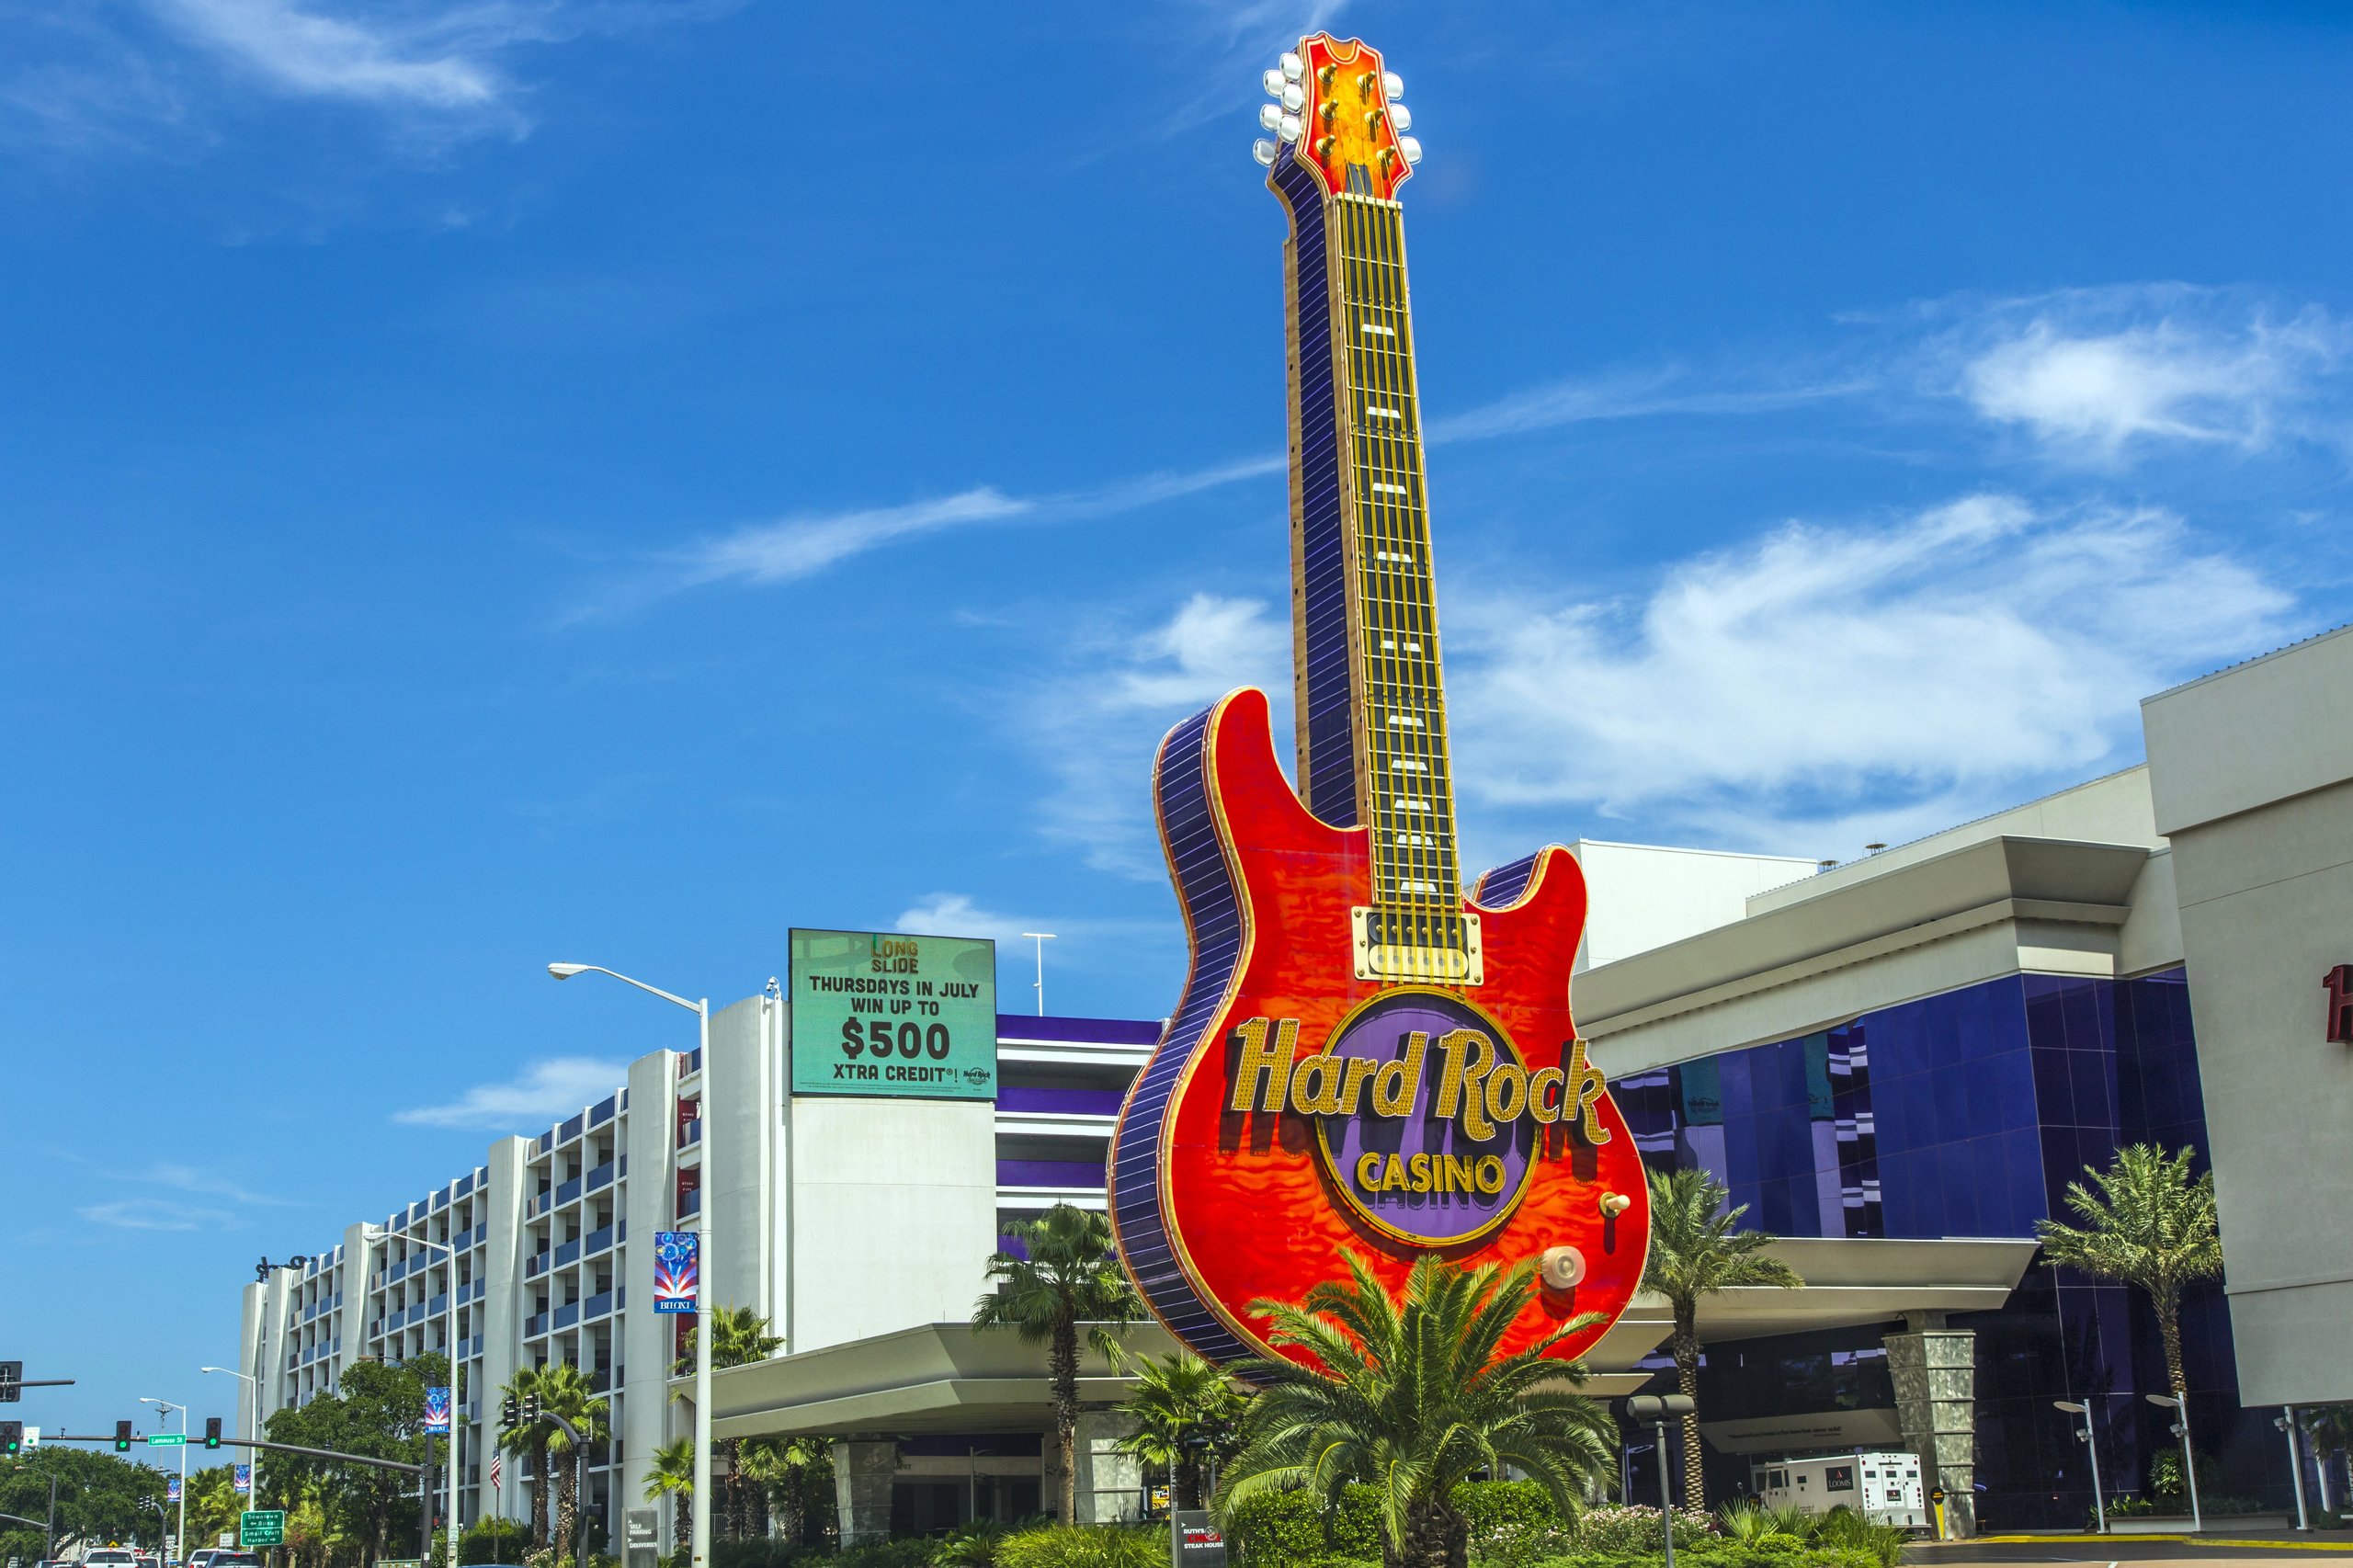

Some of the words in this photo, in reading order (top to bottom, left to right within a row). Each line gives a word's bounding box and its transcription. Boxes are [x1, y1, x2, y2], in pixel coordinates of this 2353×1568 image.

[871, 939, 919, 959] LONG
[871, 958, 919, 974] SLIDE
[809, 976, 910, 995] THURSDAYS
[916, 982, 933, 996] IN
[939, 983, 979, 998] JULY
[851, 997, 883, 1014] WIN
[891, 999, 912, 1015] UP
[918, 1001, 939, 1016] TO
[841, 1017, 949, 1060] $500
[833, 1063, 879, 1080] XTRA
[978, 1071, 991, 1079] Rock
[1231, 1017, 1429, 1118] Hard
[1435, 1028, 1612, 1145] Rock
[1357, 1152, 1506, 1194] CASINO
[660, 1301, 690, 1310] BILOXI
[1828, 1479, 1851, 1488] LOOMIS
